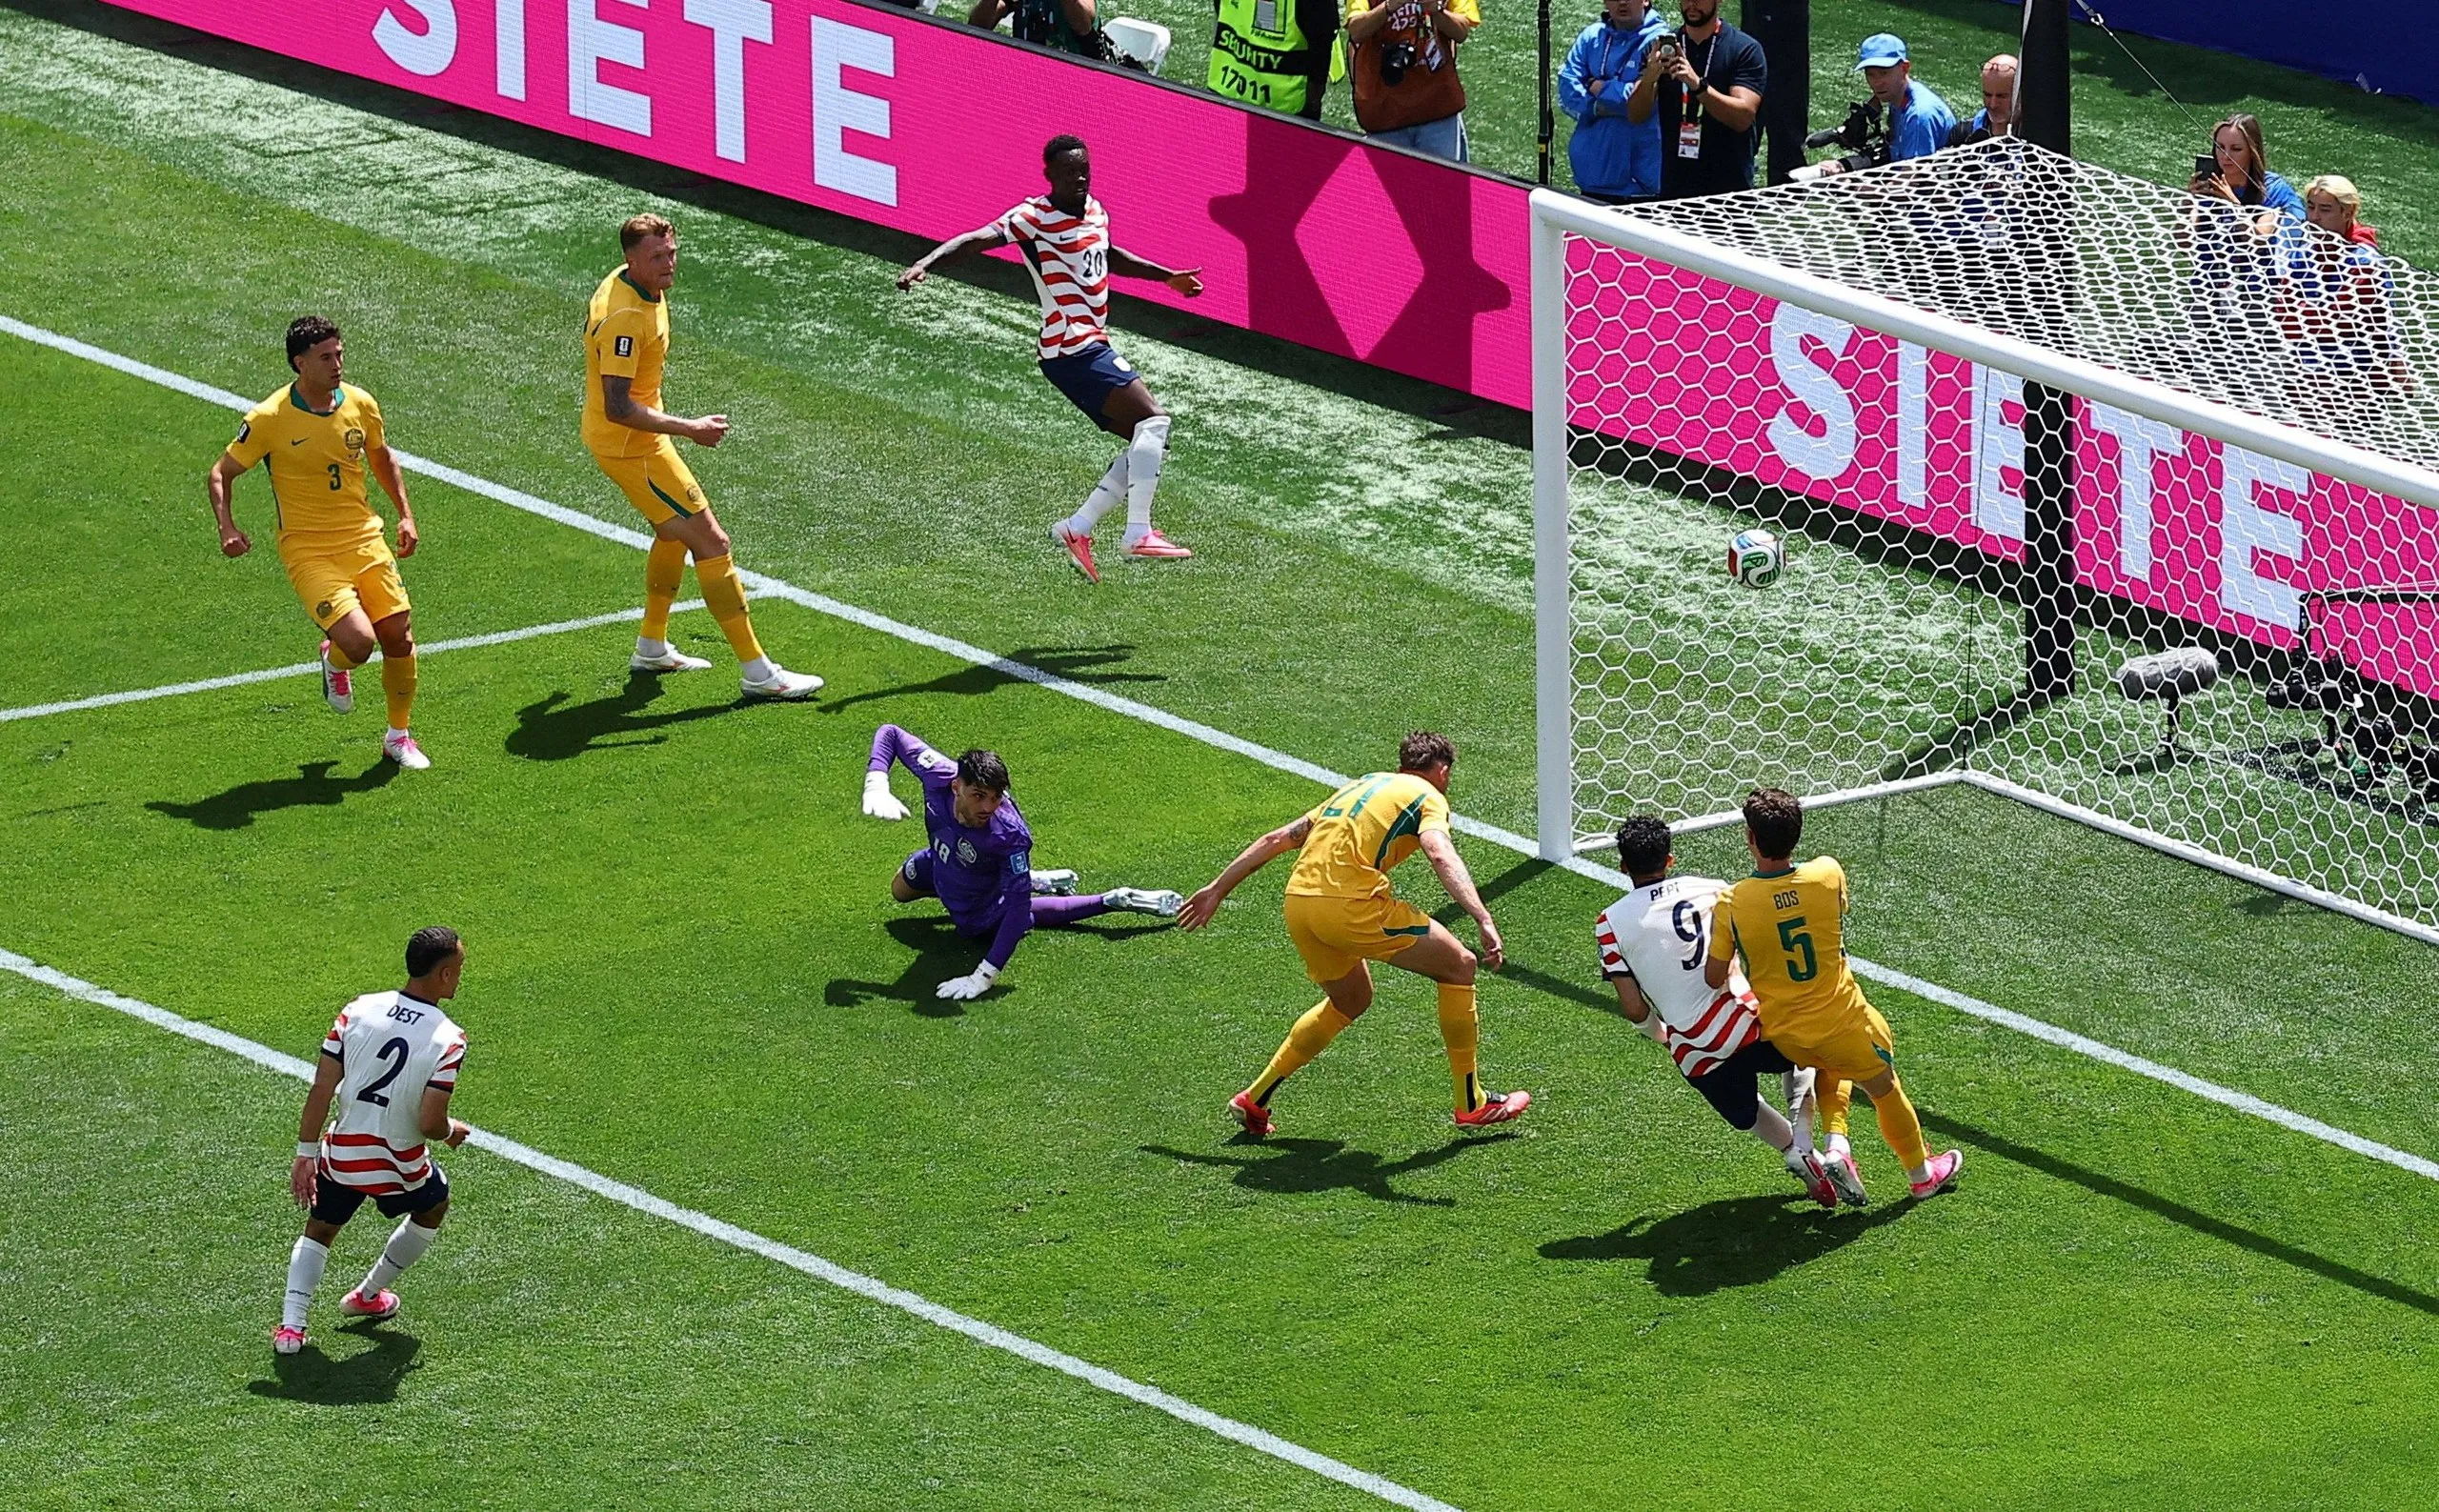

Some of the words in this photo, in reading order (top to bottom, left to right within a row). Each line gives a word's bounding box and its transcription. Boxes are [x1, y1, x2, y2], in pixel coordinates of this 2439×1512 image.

[1218, 30, 1284, 70] SEUITY
[1221, 66, 1271, 104] 17011
[1082, 250, 1102, 278] 20
[327, 463, 342, 492] 3
[1764, 299, 2310, 635] SIETE
[934, 837, 951, 865] 18
[1773, 890, 1800, 911] BOS
[1672, 899, 1704, 971] 9
[1776, 916, 1819, 983] 5
[386, 1004, 426, 1026] DEST
[355, 1036, 410, 1109] 2
